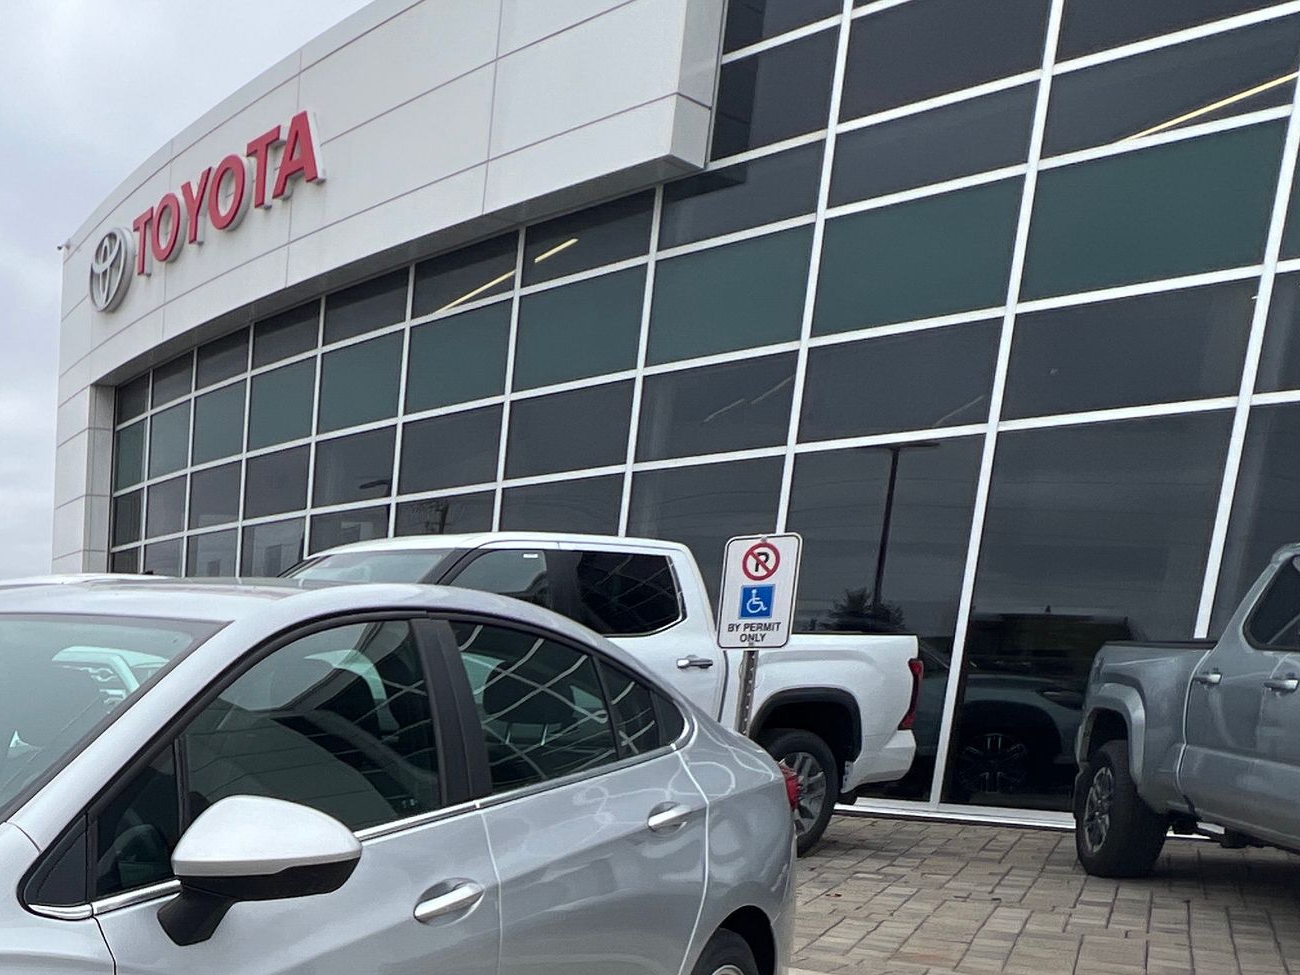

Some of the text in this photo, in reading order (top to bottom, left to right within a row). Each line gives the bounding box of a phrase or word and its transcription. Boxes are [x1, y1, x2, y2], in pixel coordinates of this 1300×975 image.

[133, 110, 320, 277] TOYOTA
[727, 622, 781, 632] BY PERMIT
[740, 633, 766, 642] ONLY
